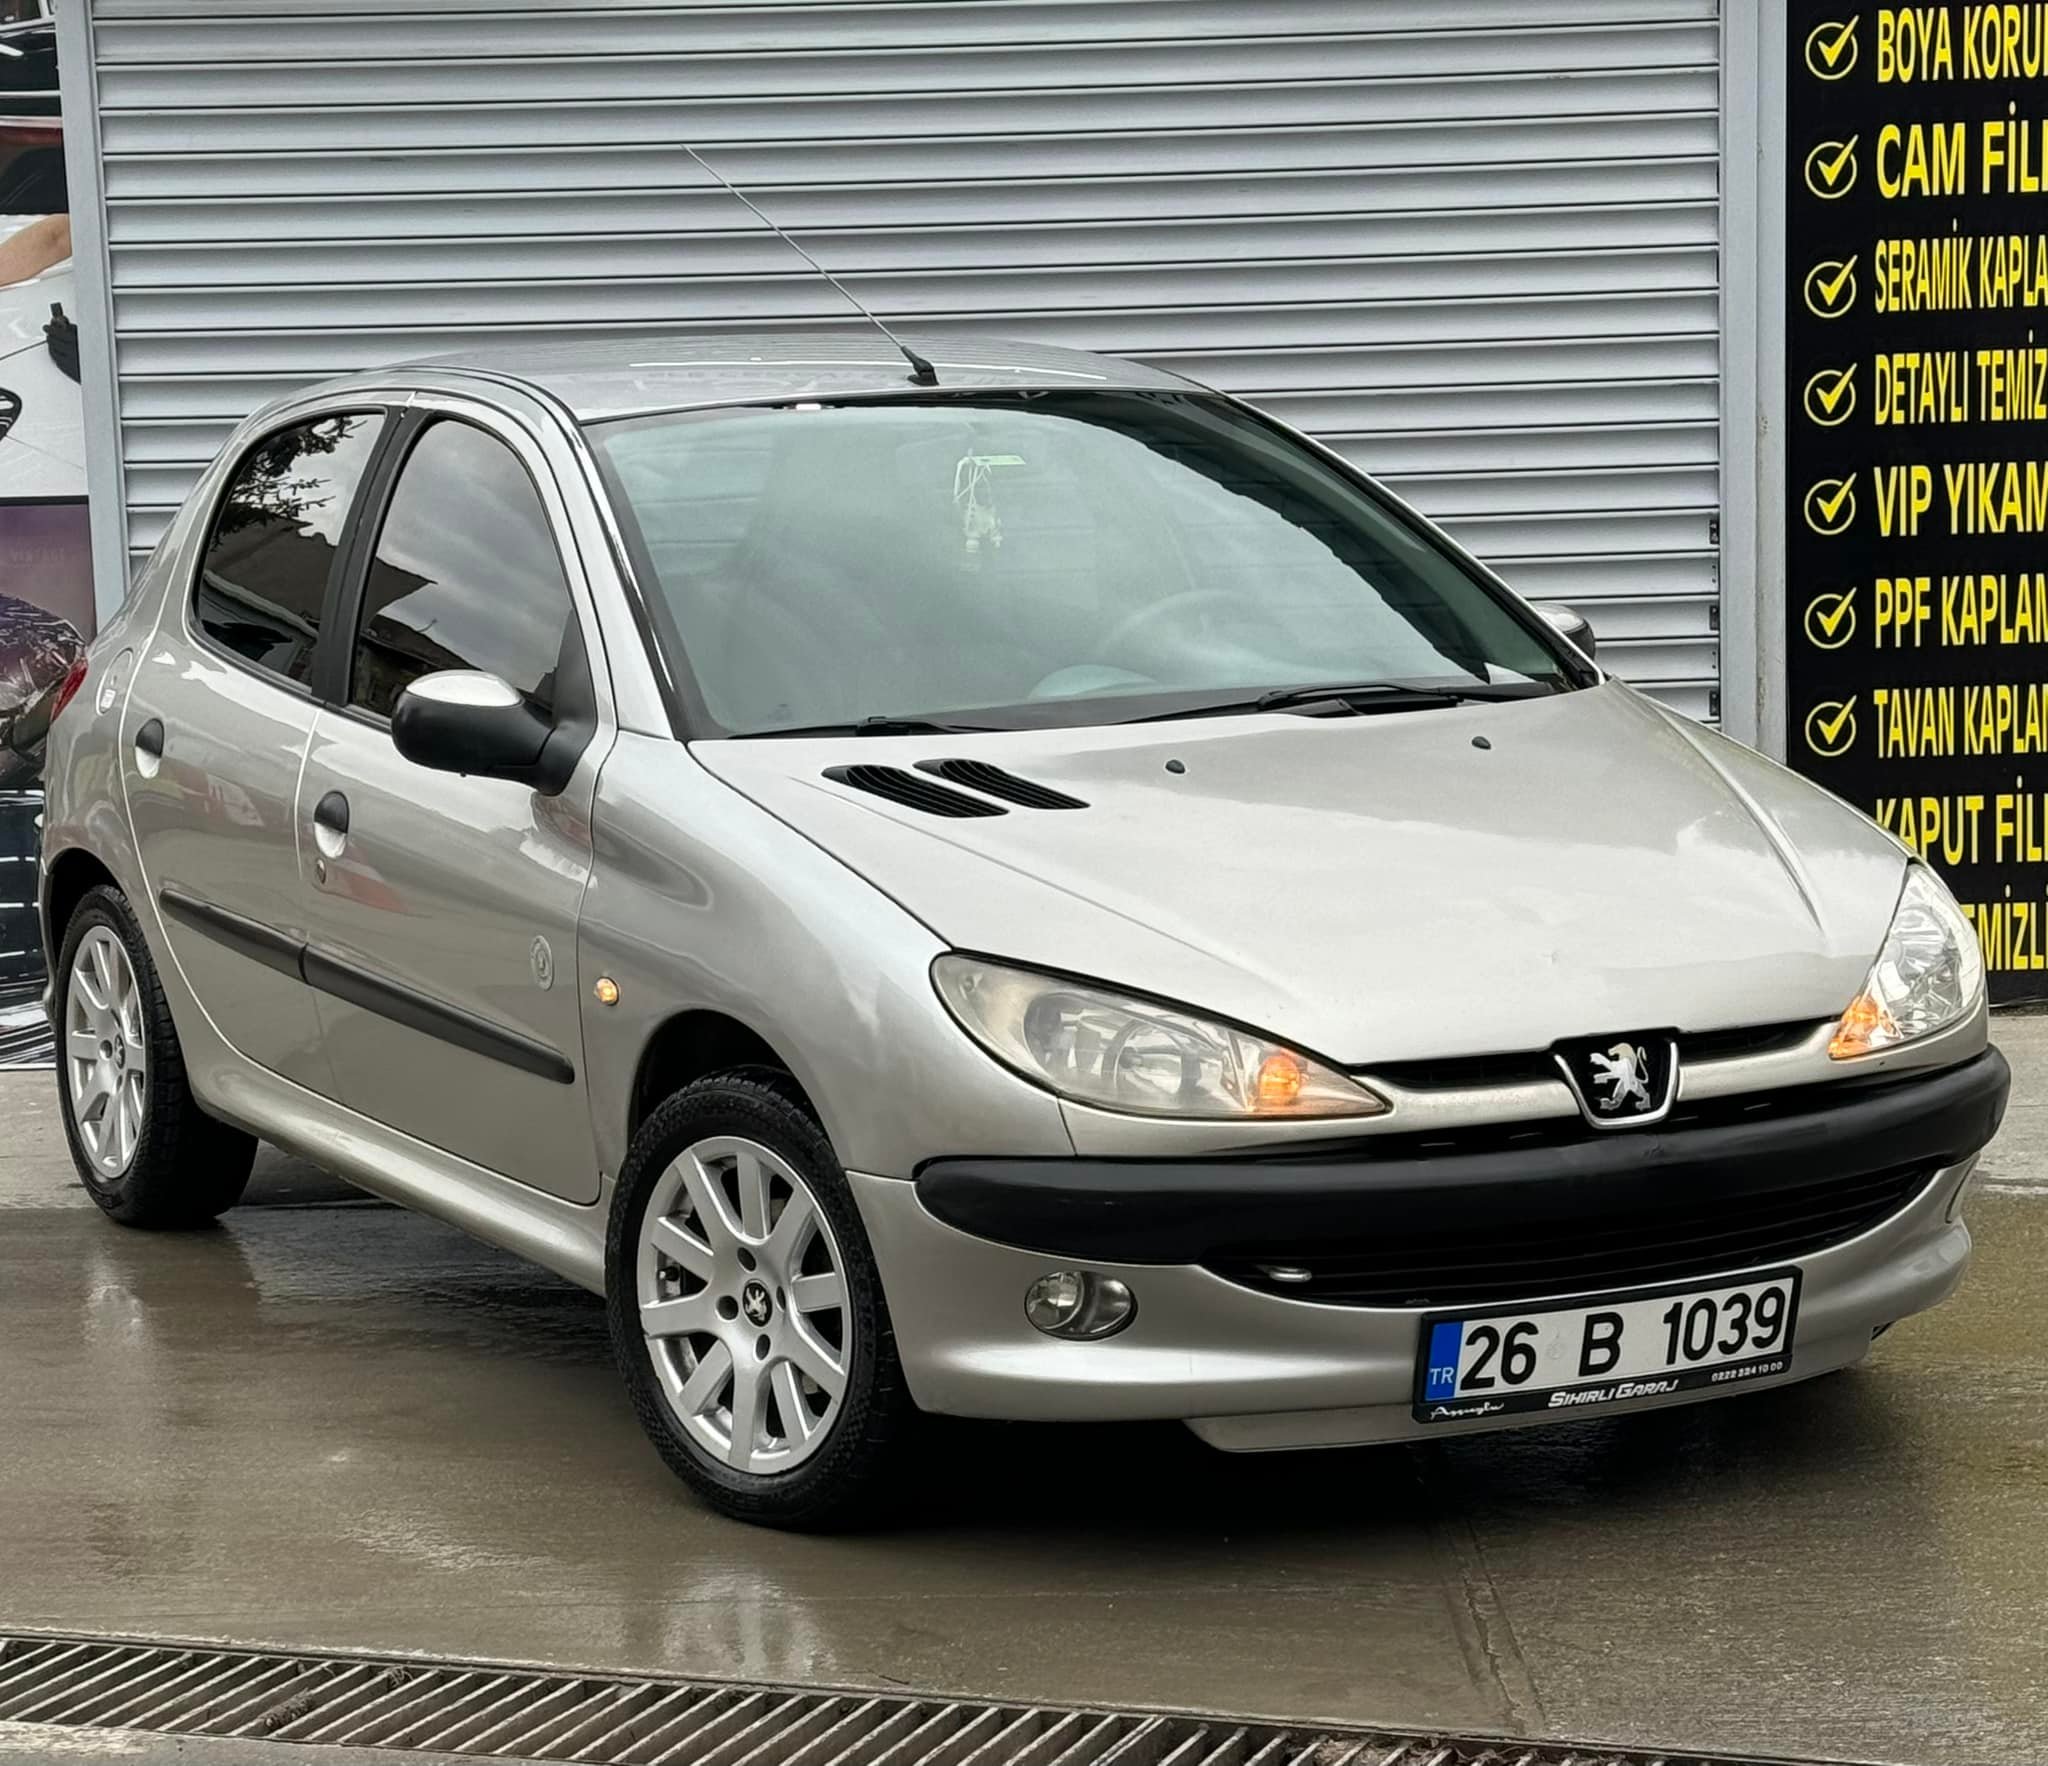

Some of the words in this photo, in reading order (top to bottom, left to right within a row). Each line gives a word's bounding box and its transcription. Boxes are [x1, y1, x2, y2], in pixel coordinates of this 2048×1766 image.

[1877, 7, 1954, 83] BOYA
[1963, 3, 2048, 80] KORU
[1876, 122, 1966, 199] CAM
[1982, 101, 2048, 194] FİL
[1875, 218, 1973, 314] SERAMİK
[1979, 234, 2048, 309] KAPLA
[1875, 351, 1969, 425] DETAYLI
[1976, 329, 2048, 421] TEMİZ
[1873, 465, 1933, 537] VIP
[1875, 576, 1931, 649] PPF
[1873, 686, 1955, 758] TAVAN
[1964, 683, 2048, 755] KAPLA
[1995, 775, 2048, 863] FİL
[1430, 1366, 1455, 1385] TR
[1459, 1321, 1539, 1391] 26
[1578, 1311, 1624, 1377] B
[1663, 1286, 1786, 1366] 1039
